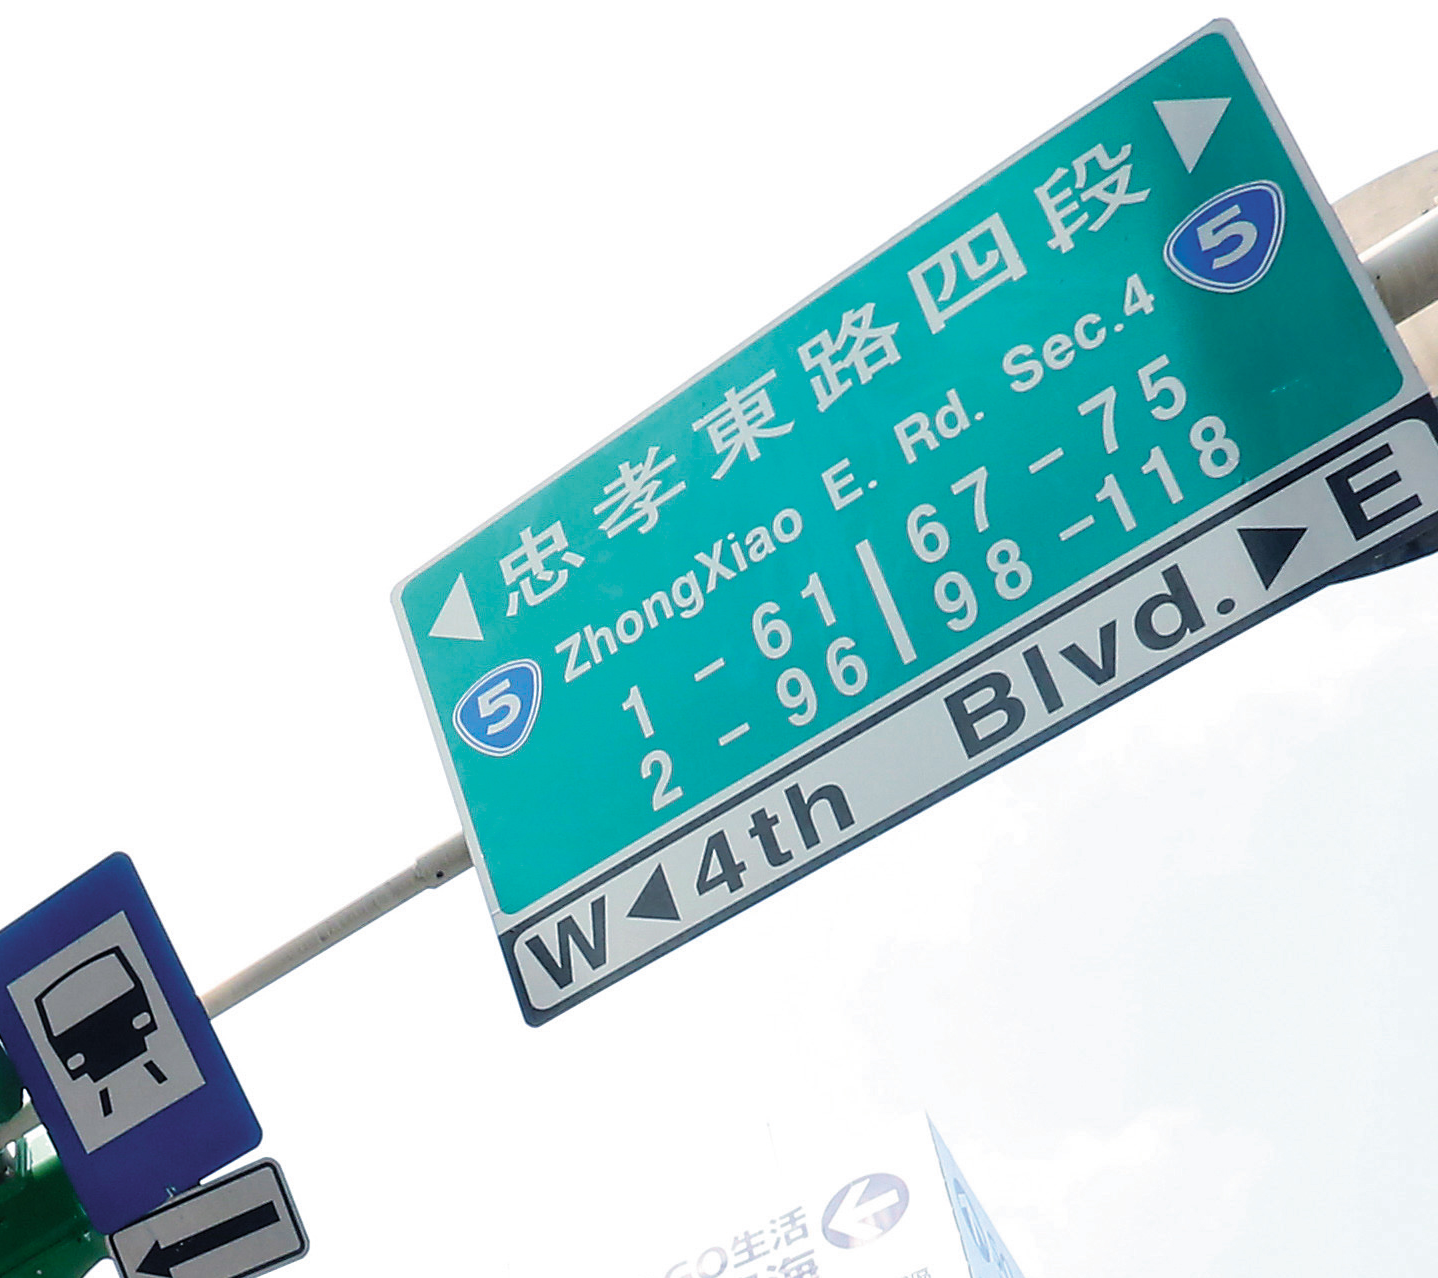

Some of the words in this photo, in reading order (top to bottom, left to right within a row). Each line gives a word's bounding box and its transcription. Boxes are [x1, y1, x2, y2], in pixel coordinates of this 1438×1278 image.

[1199, 197, 1260, 273] 5
[496, 140, 1152, 622] 忠孝東路四段
[552, 500, 808, 690] ZhongXiao
[820, 461, 878, 513] E.
[893, 401, 986, 467] Rd.
[474, 675, 530, 738] 5
[521, 895, 612, 992] W
[694, 781, 857, 896] 4th
[940, 565, 1239, 764] Blvd.
[1335, 454, 1424, 538] E
